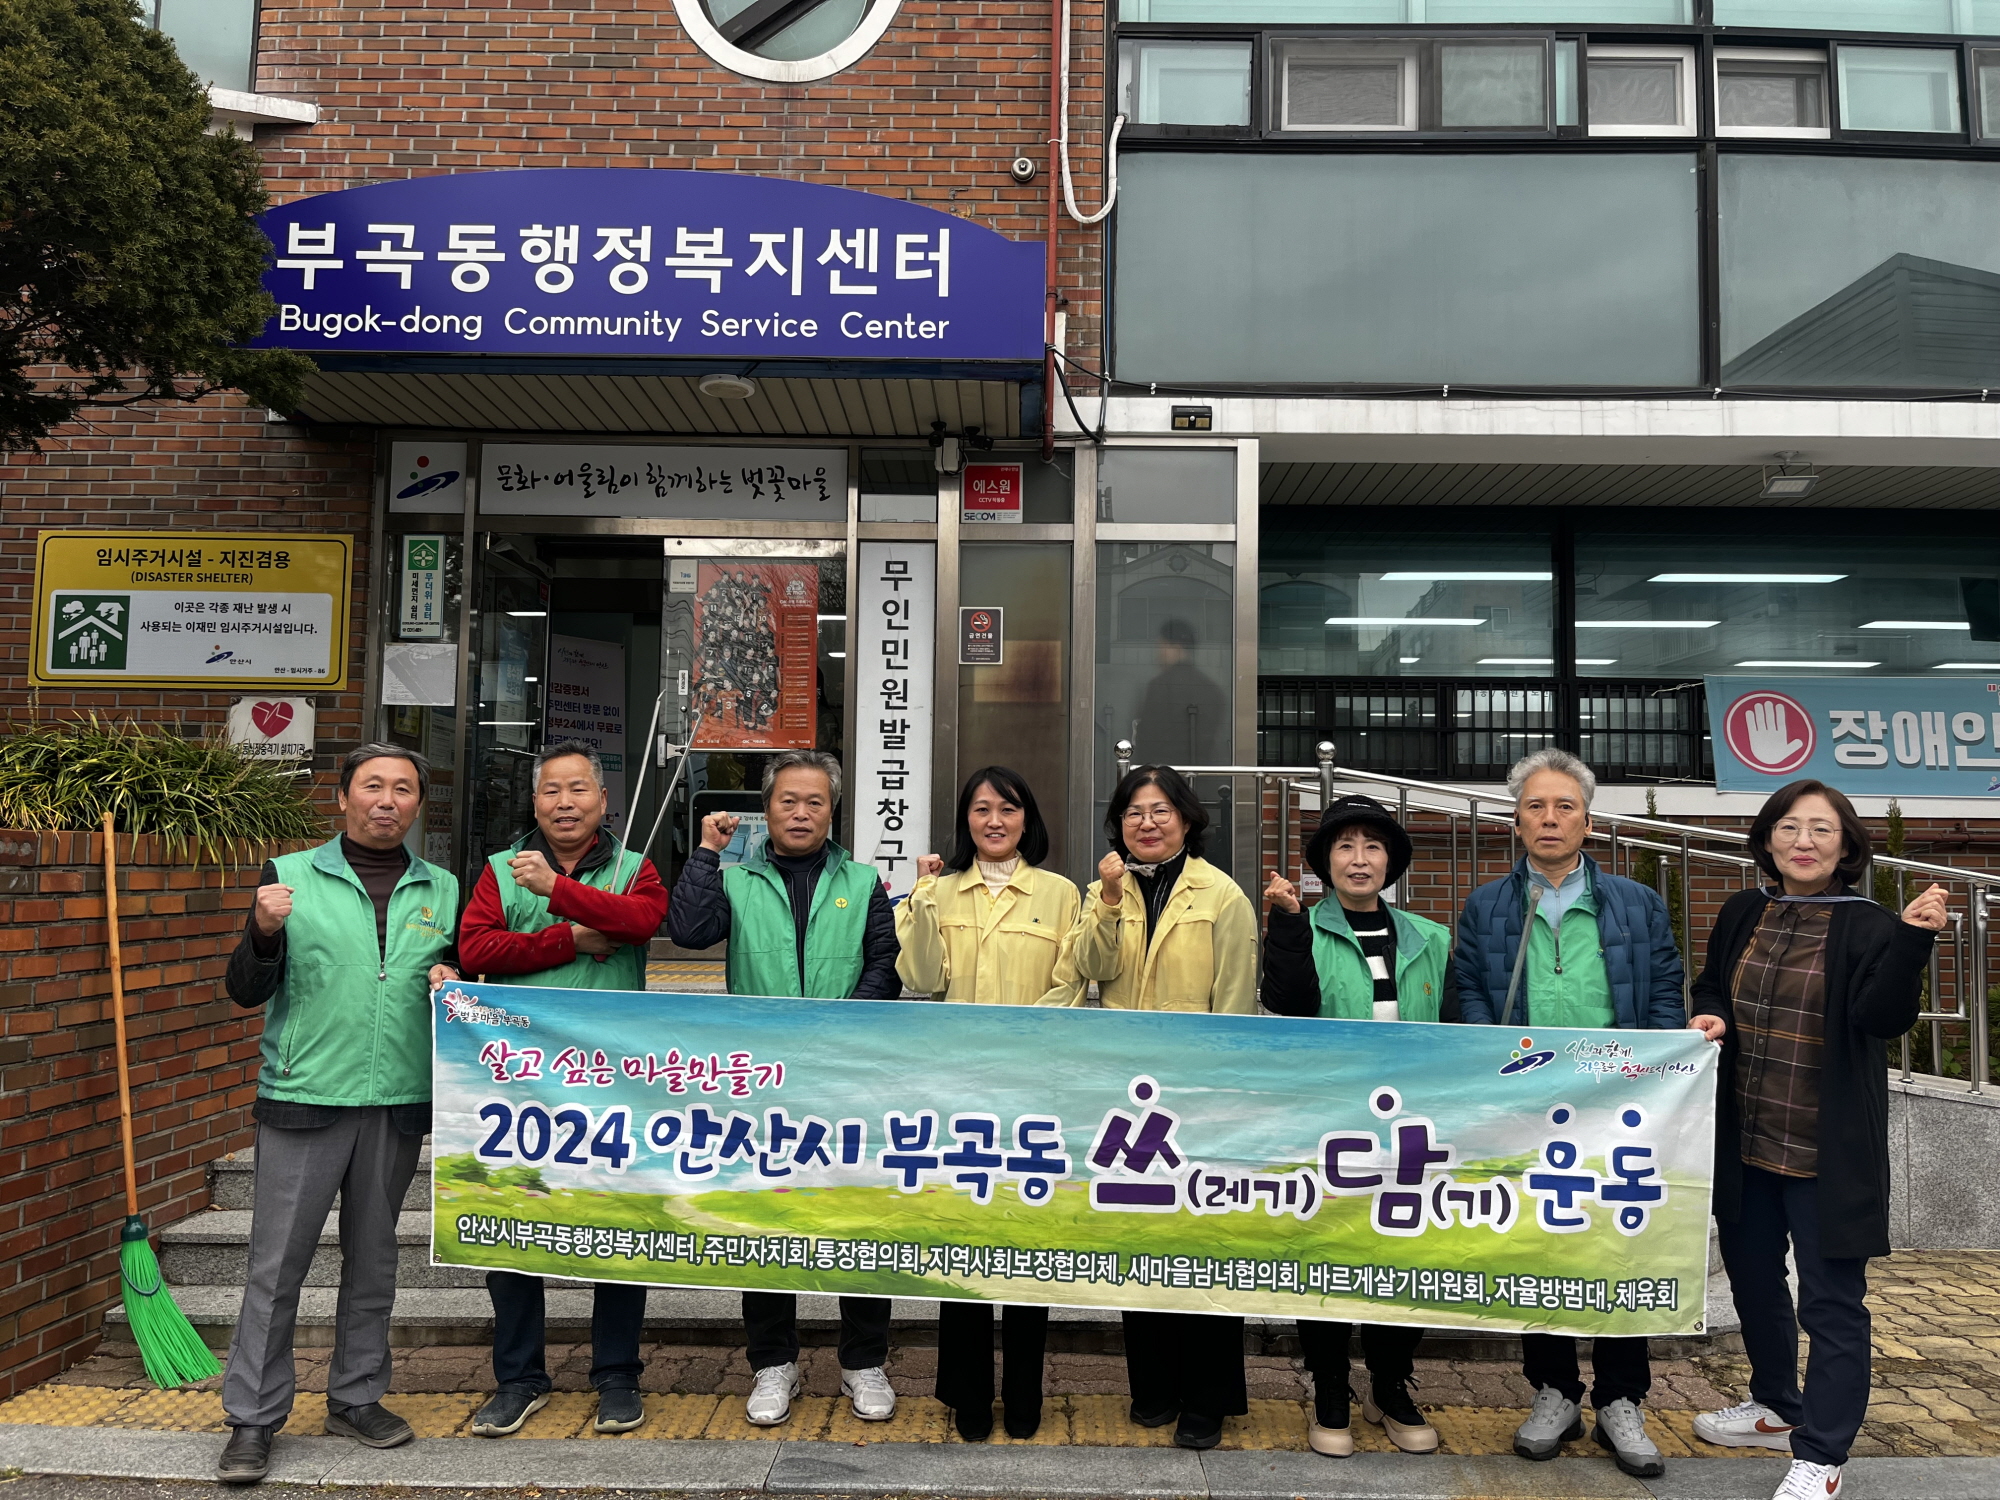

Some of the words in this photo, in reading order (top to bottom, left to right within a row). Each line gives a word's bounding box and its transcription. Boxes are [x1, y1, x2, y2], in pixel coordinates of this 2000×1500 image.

[277, 222, 950, 297] 부곡동행정복지센터
[280, 304, 482, 341] Bugok-dong
[504, 307, 682, 342] Community
[700, 309, 818, 339] Service
[840, 311, 950, 340] Center
[646, 462, 733, 498] 함께하는
[742, 465, 831, 502] 벚꽃마을
[973, 479, 1011, 494] 에스원
[964, 512, 996, 521] SECOM
[96, 548, 203, 568] 임시주거시설
[219, 550, 291, 569] 지진겸용
[131, 571, 194, 584] (DISASTER
[196, 572, 254, 585] SHELTER)
[410, 572, 419, 603] 미세먼지
[423, 573, 433, 600] 무더위
[174, 602, 206, 614] 이곳은
[208, 602, 230, 614] 각종
[232, 602, 254, 614] 재난
[257, 602, 278, 615] 발생
[281, 603, 292, 615] 시
[410, 604, 418, 621] 쉼터
[423, 602, 432, 620] 쉼터
[140, 621, 182, 633] 사용되는
[185, 621, 217, 633] 이재민
[220, 622, 318, 634] 임시주거시설입니다.
[583, 703, 601, 716] 방문
[602, 706, 620, 718] 없이
[726, 701, 732, 709] 3
[875, 560, 913, 872] 무인민원발급창구
[596, 722, 622, 734] 무료로
[460, 1011, 500, 1025] 벚꽃마을
[503, 1015, 530, 1028] 부곡동
[480, 1041, 543, 1082] 살고
[551, 1047, 614, 1086] 싶은
[623, 1050, 784, 1096] 마을만들기
[1576, 1060, 1617, 1083] 자유로운
[1620, 1061, 1668, 1081] 혁신도시
[1668, 1062, 1700, 1075] 안산
[478, 1102, 631, 1169] 2024
[650, 1108, 862, 1178] 안산시
[882, 1115, 1067, 1201] 부곡동
[1529, 1107, 1662, 1230] 운동
[1615, 1279, 1677, 1311] 체육회
